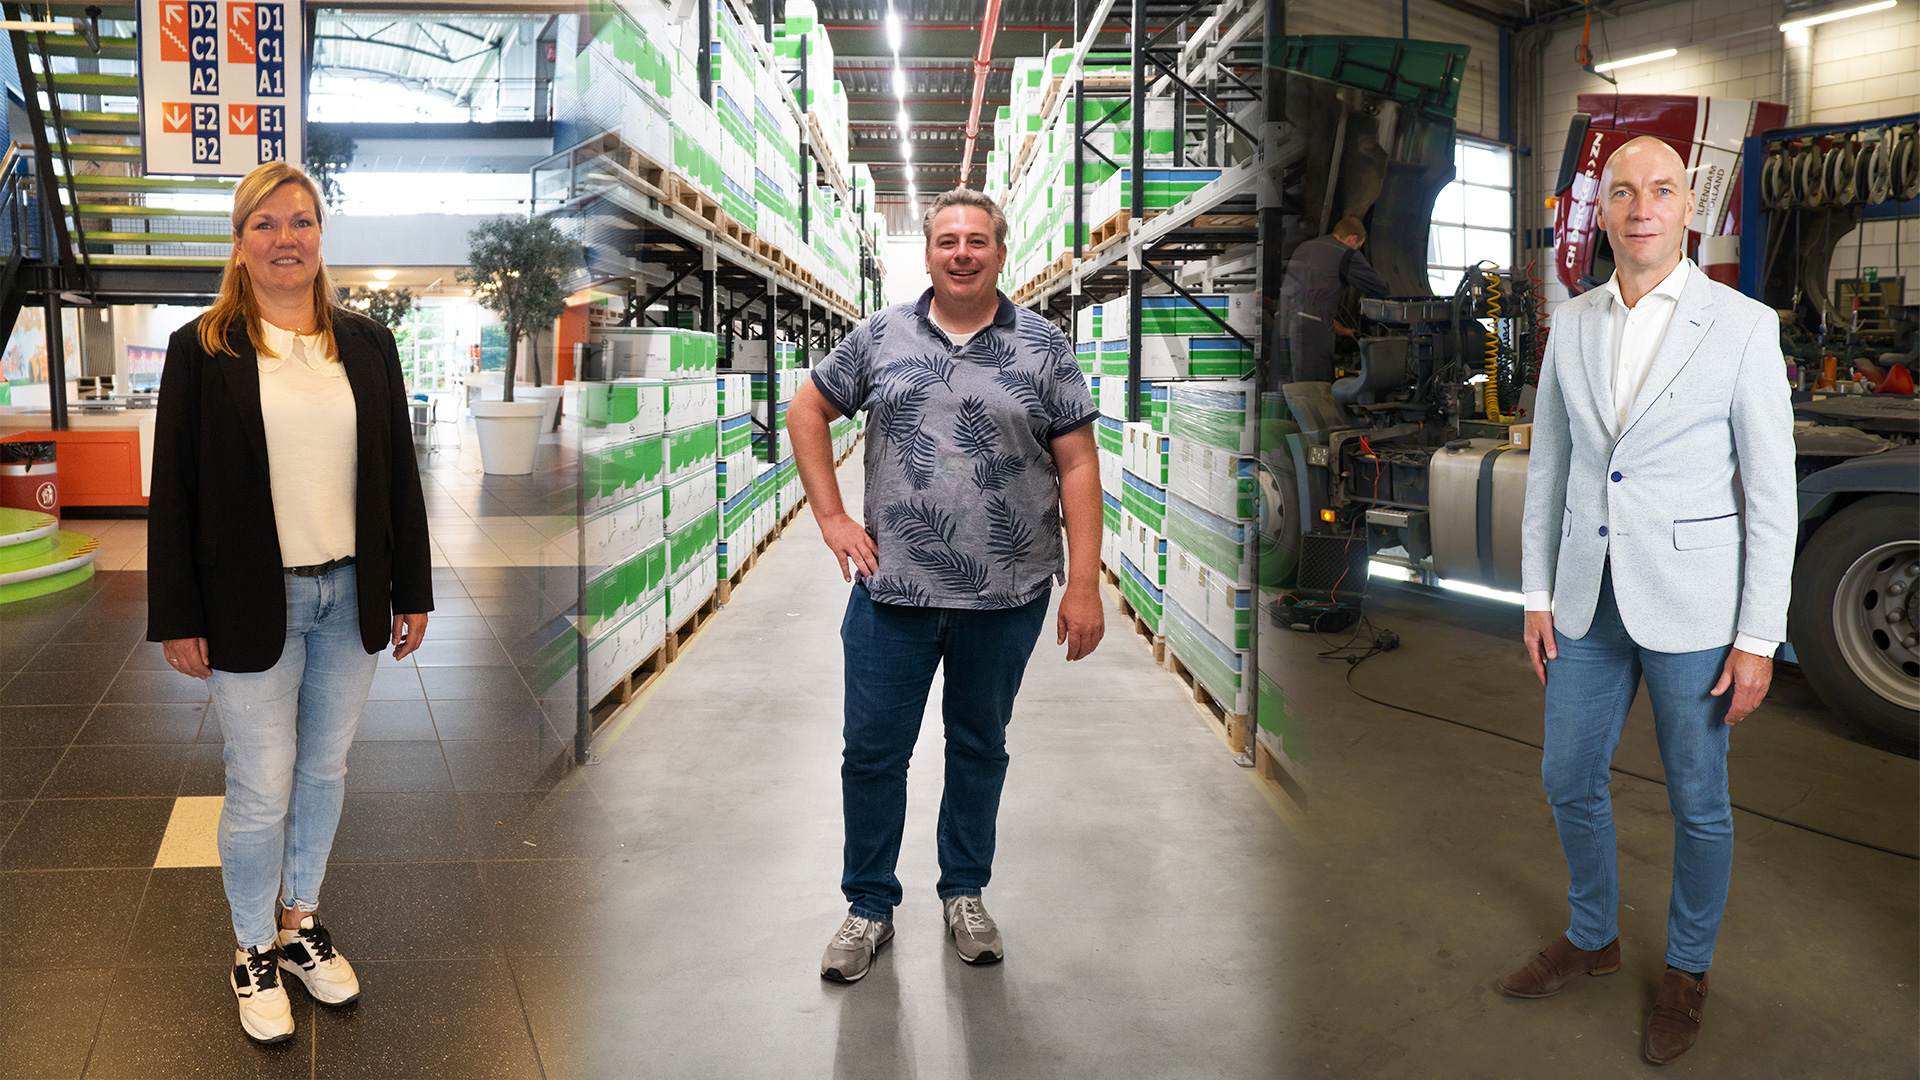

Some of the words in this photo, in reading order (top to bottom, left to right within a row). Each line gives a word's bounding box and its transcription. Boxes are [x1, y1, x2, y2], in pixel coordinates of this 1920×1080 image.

[190, 4, 216, 29] D2
[257, 6, 283, 31] D1
[191, 35, 217, 61] C2
[258, 37, 282, 62] C1
[192, 68, 217, 92] A2
[258, 69, 283, 93] A1
[194, 106, 218, 130] E2
[260, 108, 283, 132] E1
[195, 137, 219, 160] B2
[260, 138, 284, 162] B1
[1696, 165, 1717, 216] ILPENDAM
[1705, 168, 1725, 216] HOLLAND
[1565, 244, 1577, 269] CH
[1571, 169, 1595, 243] DEKKER
